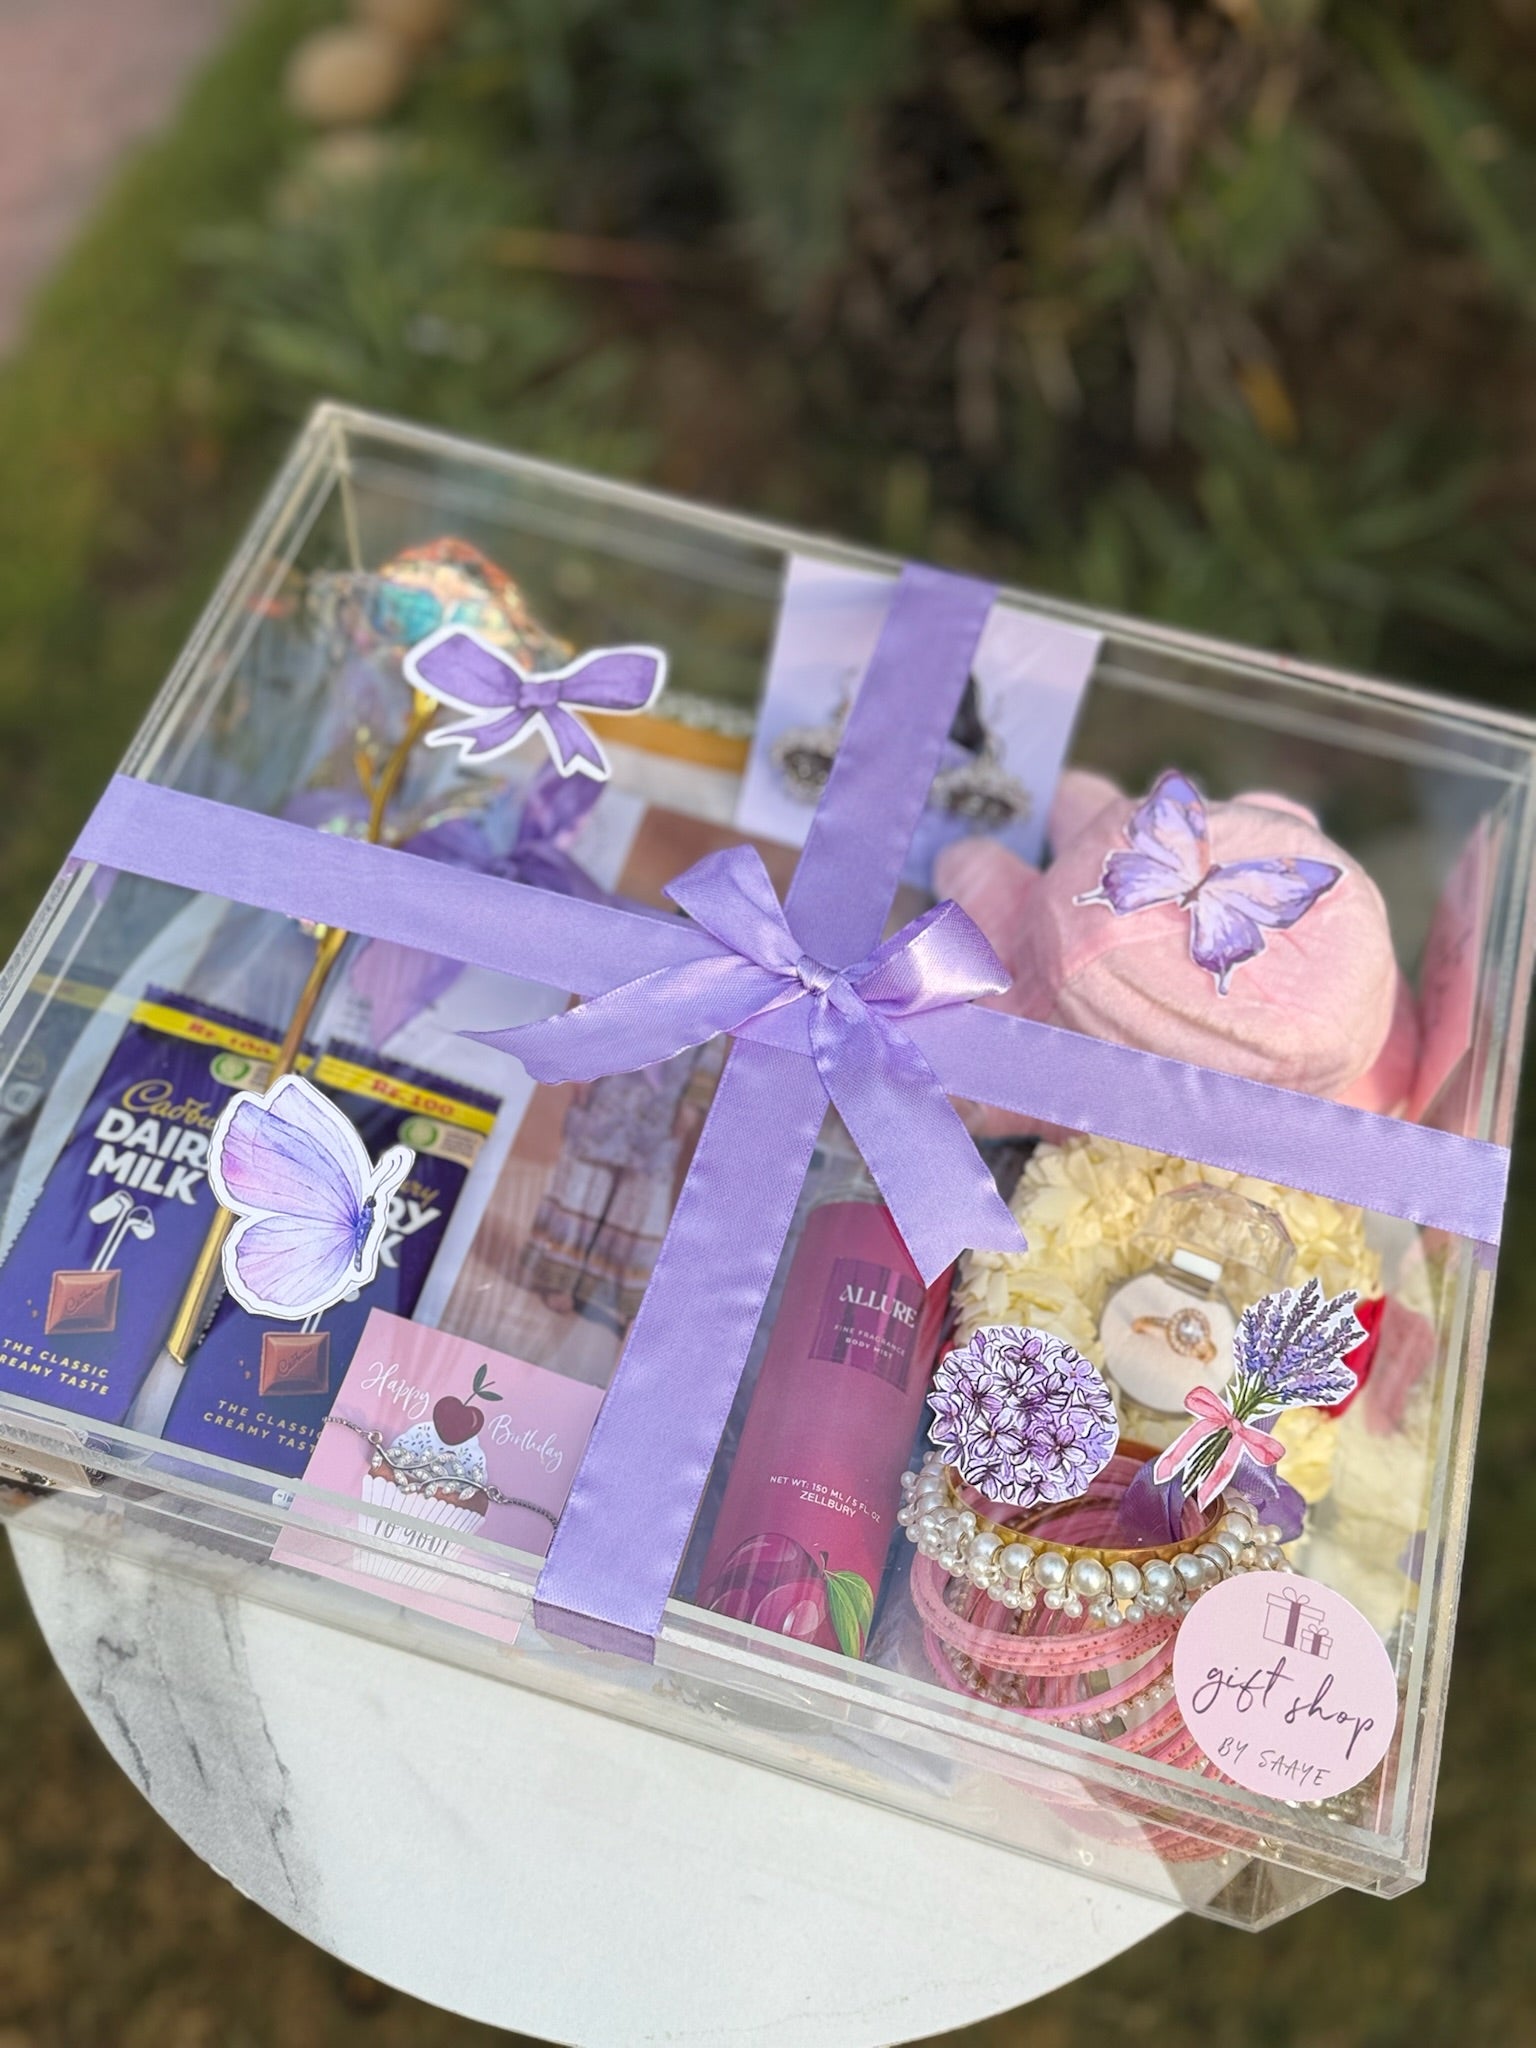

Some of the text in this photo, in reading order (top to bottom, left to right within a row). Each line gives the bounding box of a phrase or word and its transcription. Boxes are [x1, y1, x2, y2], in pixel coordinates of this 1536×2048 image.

[93, 1107, 210, 1172] DAIR
[87, 1143, 204, 1206] MILK
[839, 1284, 918, 1329] ALLURE
[2, 1338, 110, 1379] THE CLASSIC
[834, 1324, 905, 1357] FINE FRAGRANCE
[845, 1337, 893, 1360] BODY MIST
[0, 1354, 110, 1396] REAMY TASTE
[360, 1361, 431, 1420] Happy
[218, 1399, 249, 1417] THE
[203, 1412, 316, 1454] CREAMY TAST
[487, 1414, 563, 1474] Birthday
[769, 1476, 789, 1485] NET
[792, 1479, 809, 1489] WT:
[812, 1482, 828, 1494] 150
[830, 1488, 844, 1501] ML
[799, 1490, 857, 1518] ZELLBURY
[1191, 1655, 1375, 1760] gift shop
[1217, 1736, 1331, 1787] BY SAAYE
